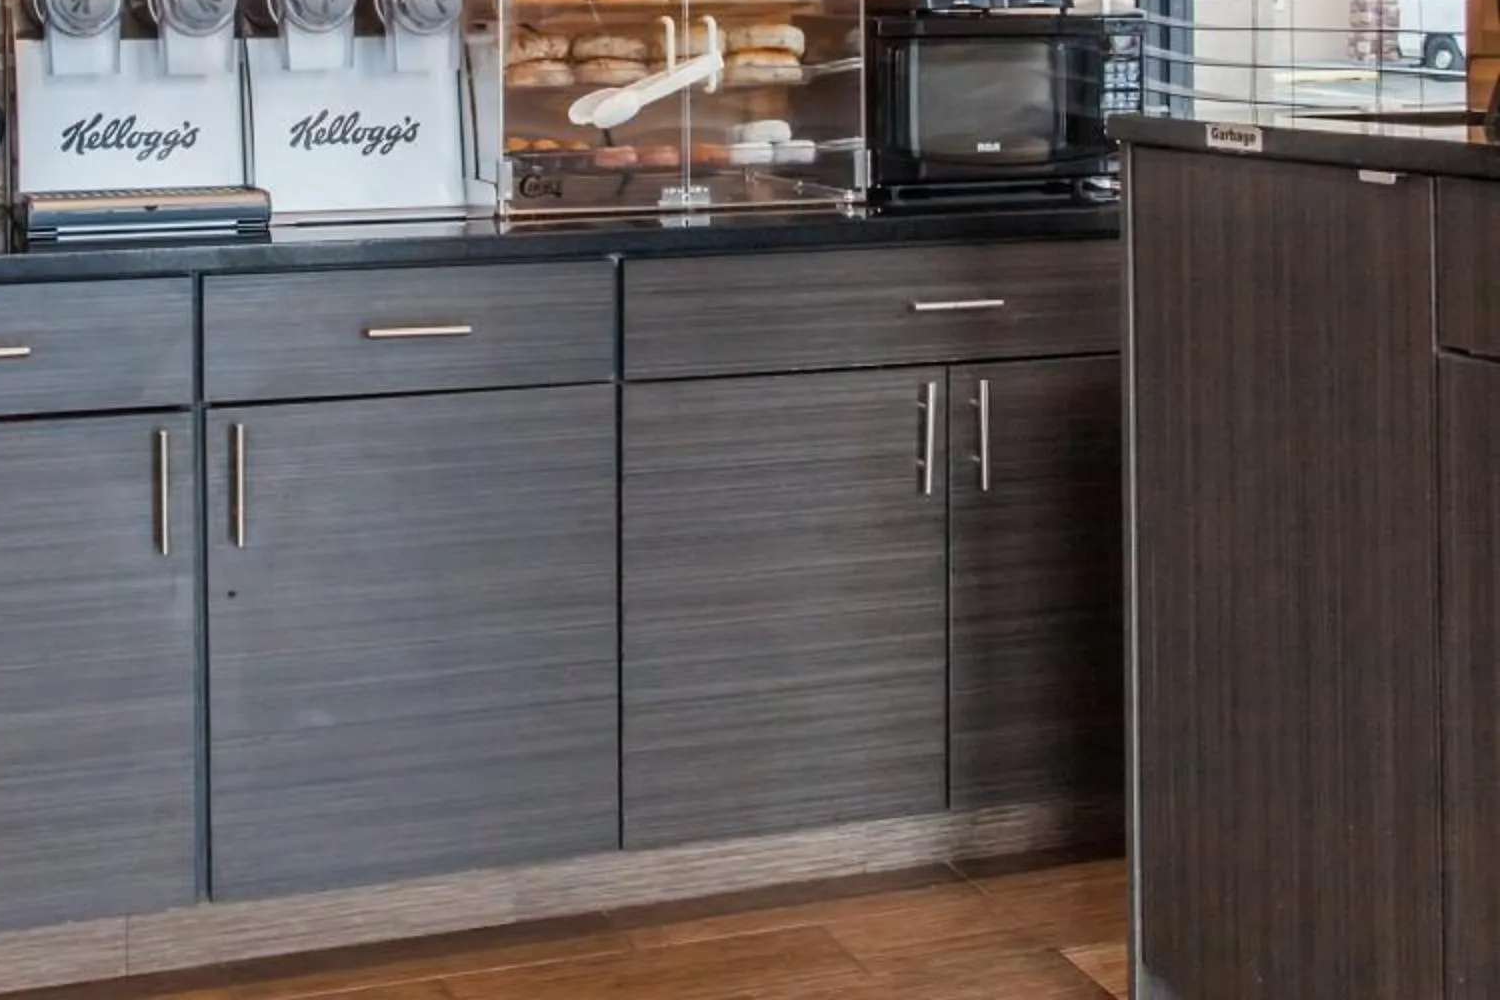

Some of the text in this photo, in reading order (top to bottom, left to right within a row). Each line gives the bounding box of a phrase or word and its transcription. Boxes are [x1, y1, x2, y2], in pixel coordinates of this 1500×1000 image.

[61, 112, 200, 161] Kellogg's
[290, 109, 420, 156] Kellogg's
[1211, 127, 1256, 146] Garbage
